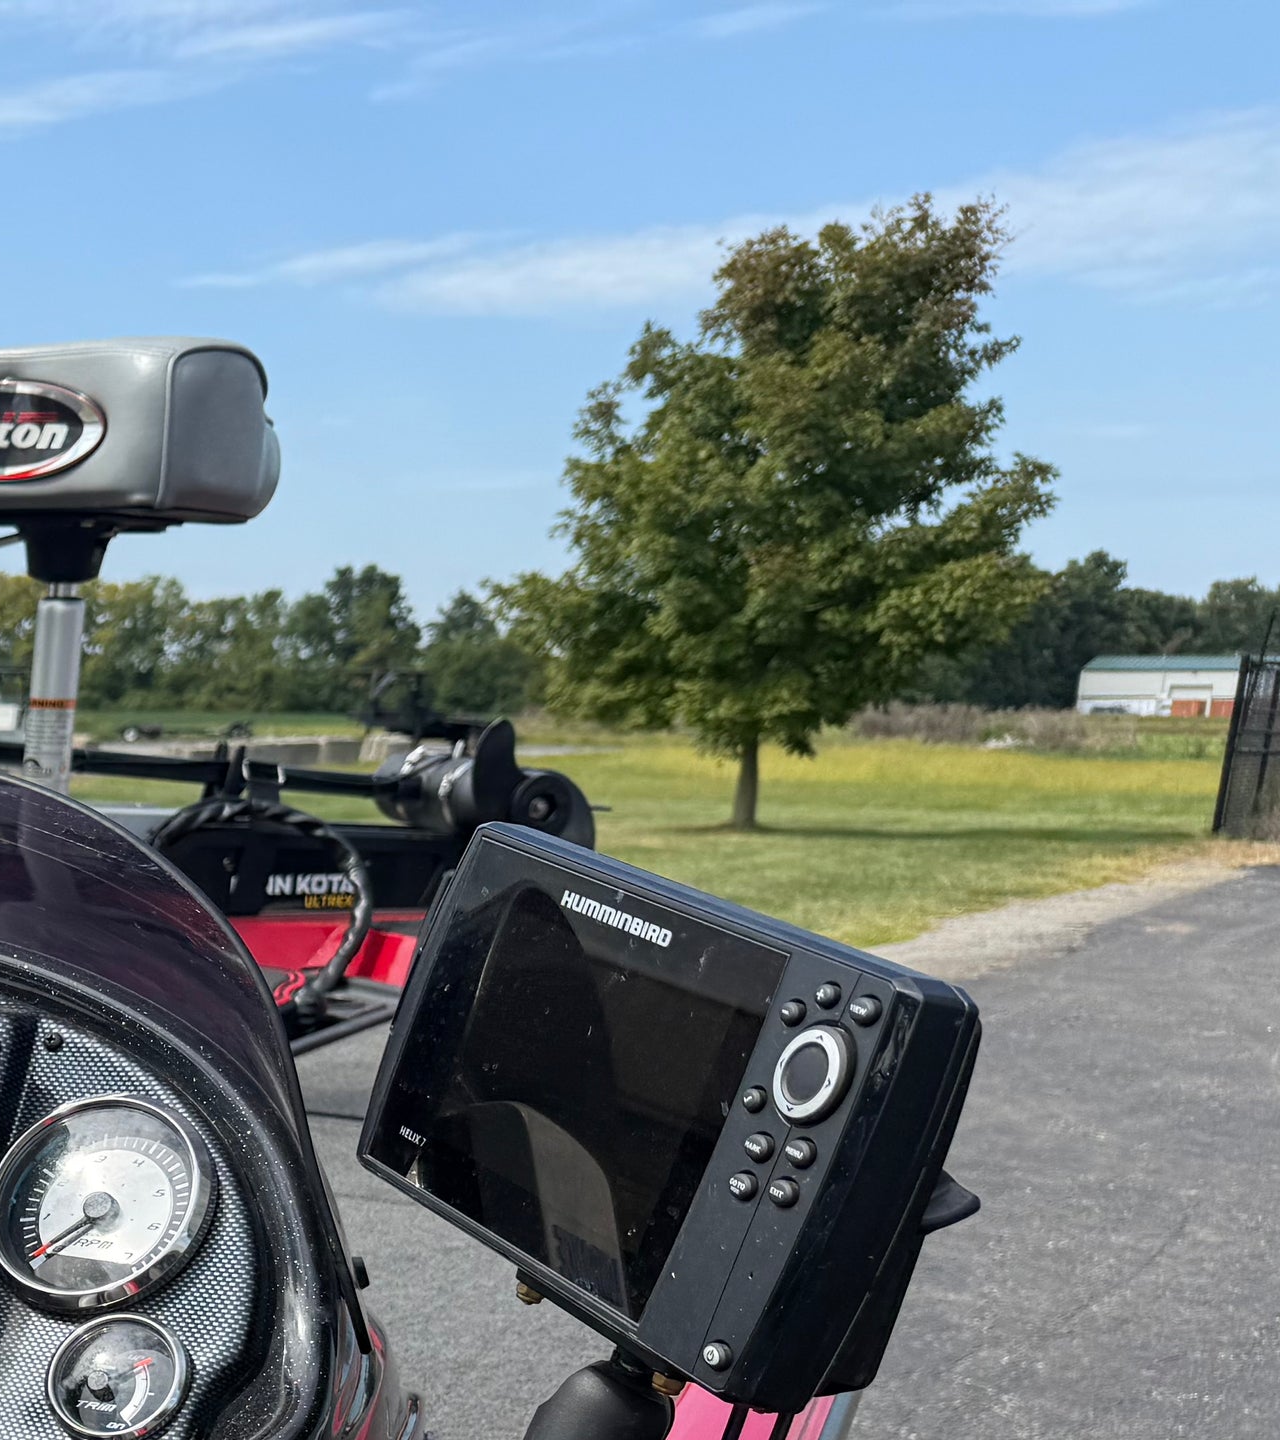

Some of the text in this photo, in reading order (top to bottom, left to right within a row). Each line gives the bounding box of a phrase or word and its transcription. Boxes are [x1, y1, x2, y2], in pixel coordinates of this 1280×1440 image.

[295, 873, 355, 895] KOTA
[560, 889, 673, 948] HUMMINBIRD
[399, 1125, 427, 1147] HELIX 7
[93, 1155, 107, 1164] 3
[132, 1157, 145, 1168] 4
[152, 1188, 165, 1198] 5
[147, 1222, 161, 1231] 6
[73, 1238, 114, 1250] RPM
[76, 1399, 117, 1412] TRIM
